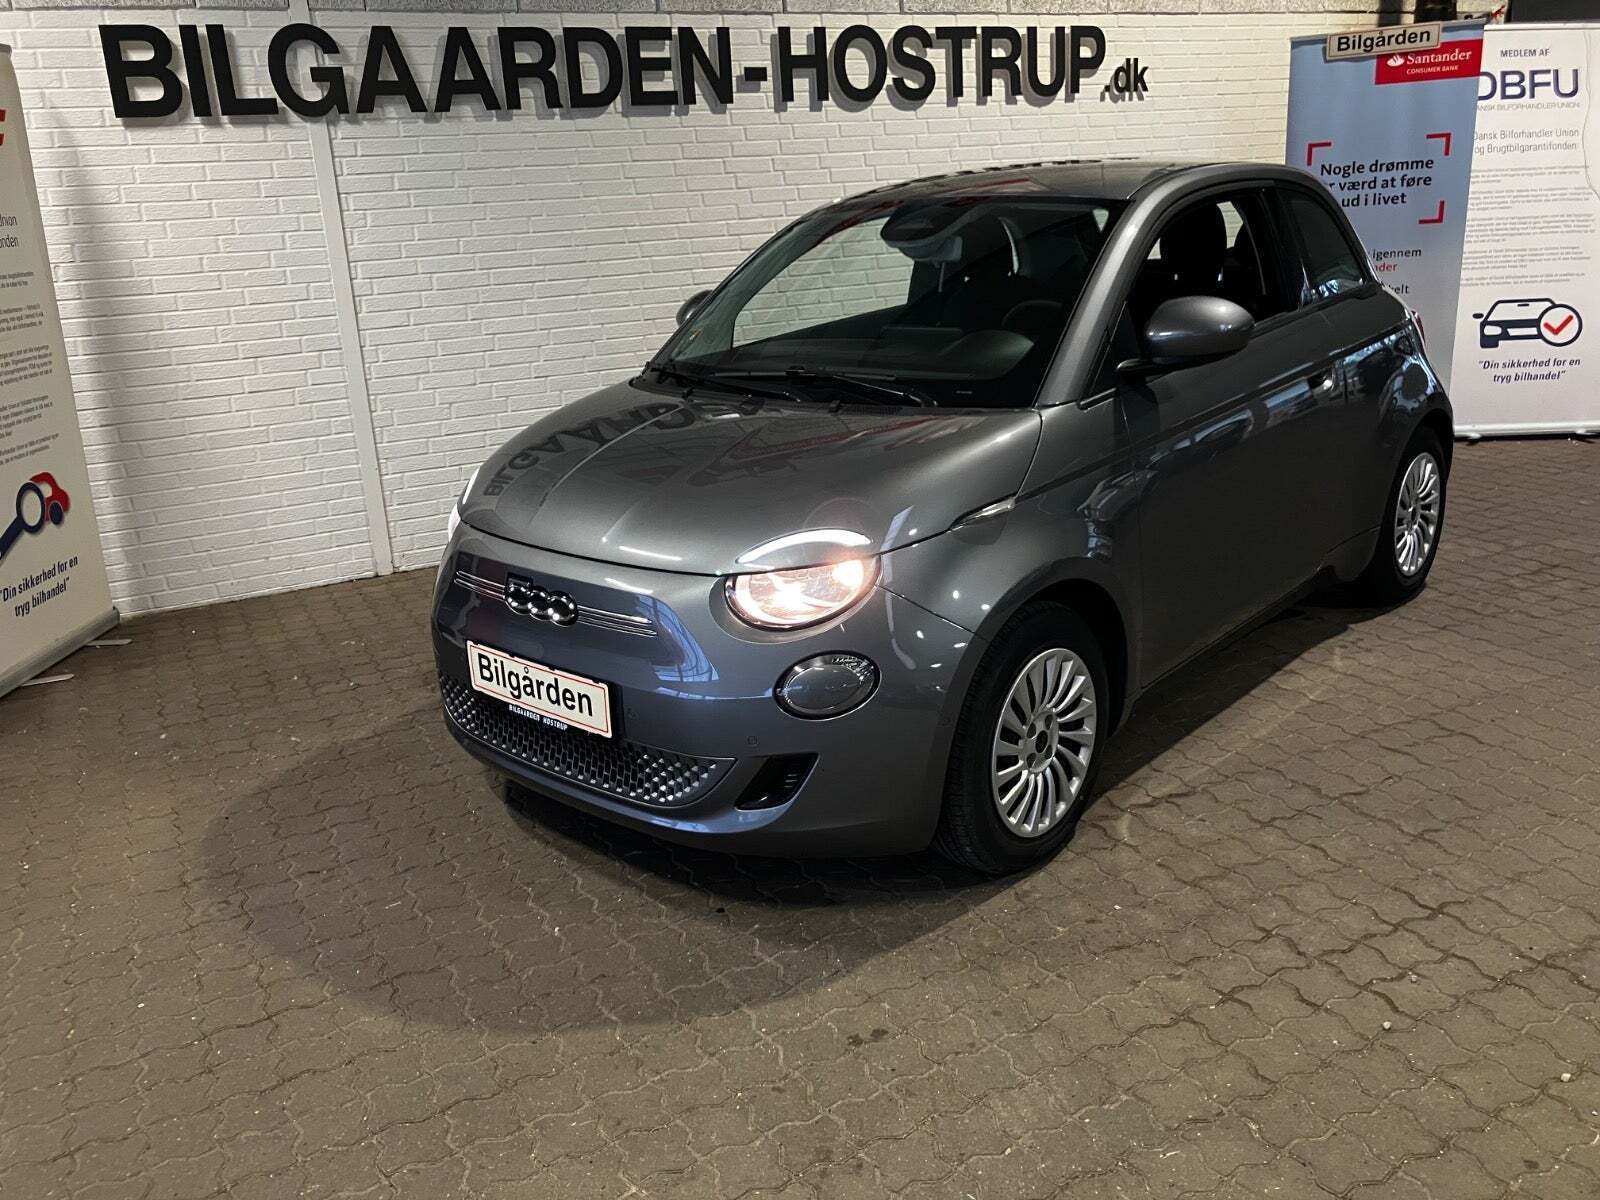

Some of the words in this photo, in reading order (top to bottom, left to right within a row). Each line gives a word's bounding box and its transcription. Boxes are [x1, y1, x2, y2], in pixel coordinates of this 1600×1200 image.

[1337, 30, 1431, 53] Bilgården
[1406, 48, 1473, 65] Santander
[1500, 49, 1537, 58] MEDLEM
[1539, 48, 1550, 57] AF
[1406, 67, 1441, 75] CONSUMER
[1442, 65, 1459, 73] BANK
[1500, 128, 1553, 140] Bilforhandler
[1556, 128, 1579, 137] Union
[1474, 146, 1485, 156] og
[1487, 141, 1577, 154] Brugtbilgarantifonden
[1321, 161, 1365, 178] Nogle
[1369, 159, 1434, 173] drømme
[1338, 177, 1377, 191] værd
[1381, 177, 1397, 189] at
[1400, 174, 1433, 187] føre
[1341, 194, 1361, 208] ud
[1364, 193, 1369, 206] i
[1373, 193, 1407, 206] livet
[1373, 249, 1422, 261] igennem
[1501, 357, 1551, 369] sikkerhed
[1552, 357, 1567, 367] for
[1493, 374, 1512, 384] tryg
[18, 563, 56, 595] sikkerhed
[57, 561, 68, 575] for
[69, 556, 79, 568] en
[15, 601, 31, 617] tryg
[478, 653, 593, 717] Bilgården
